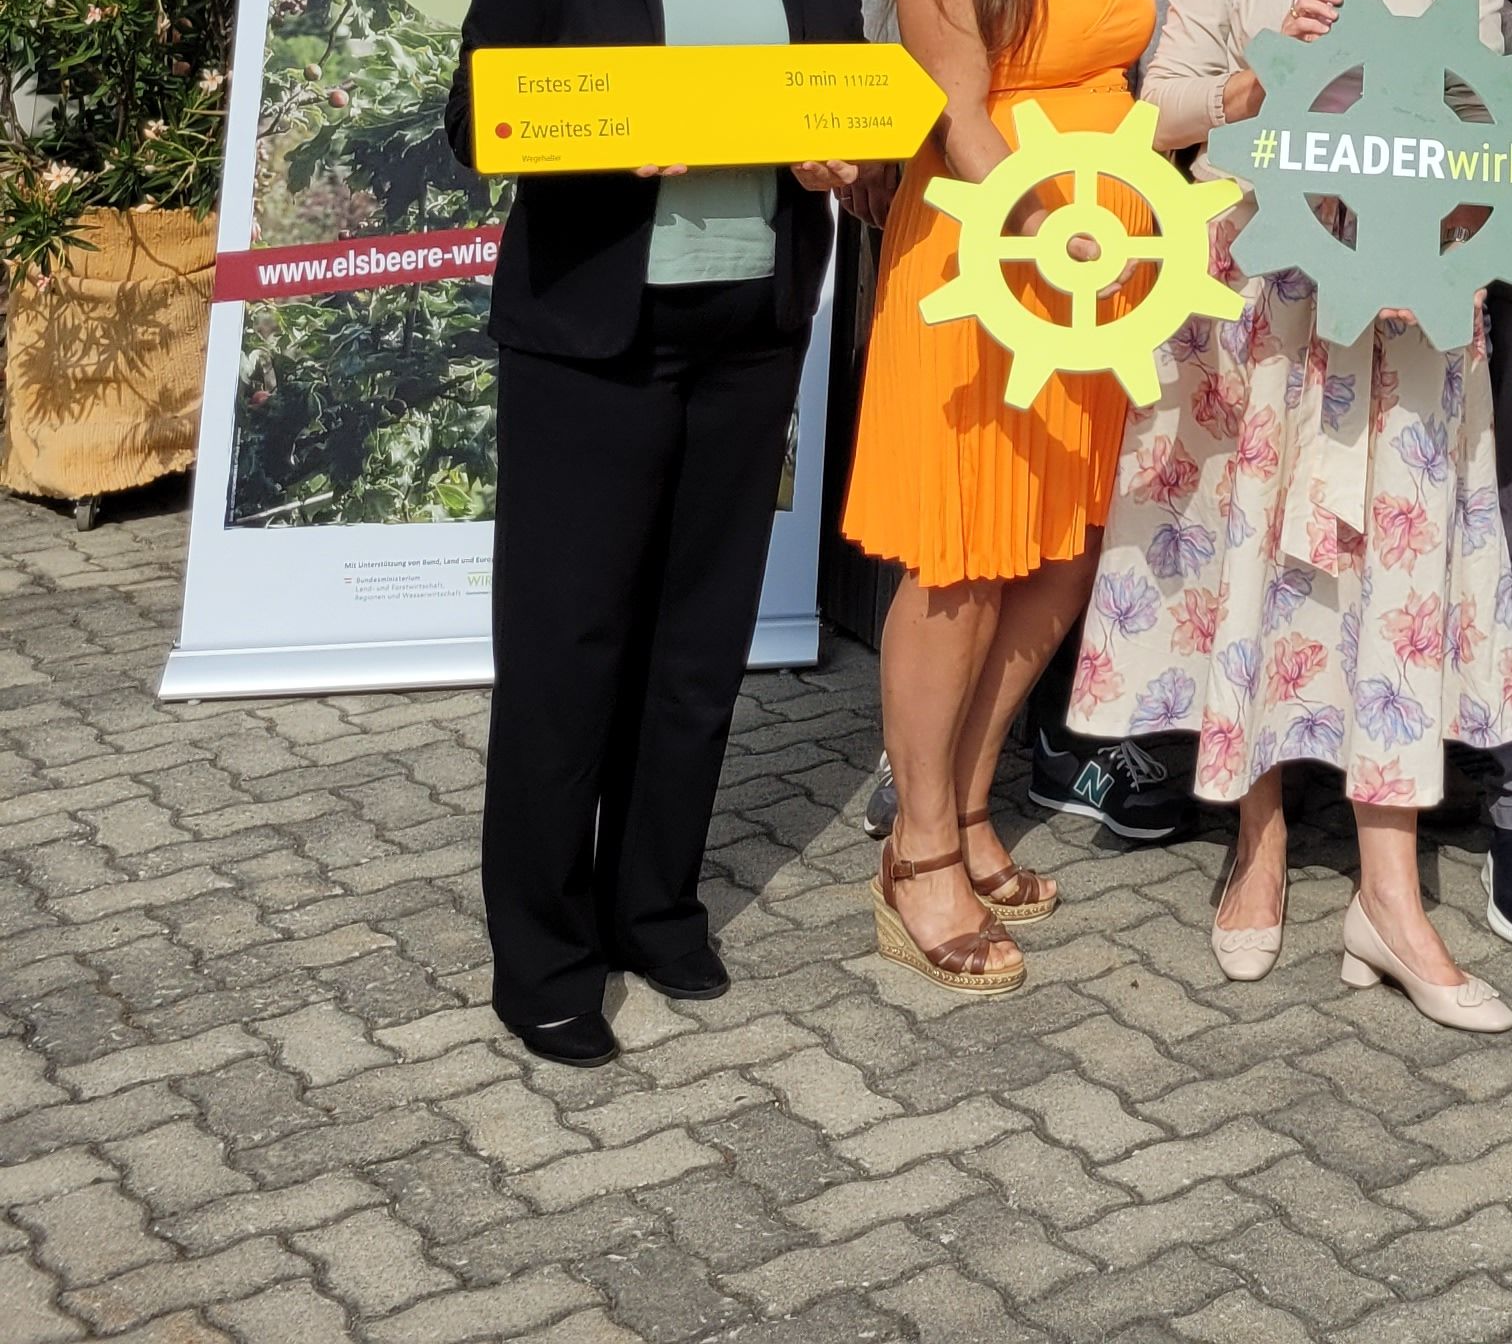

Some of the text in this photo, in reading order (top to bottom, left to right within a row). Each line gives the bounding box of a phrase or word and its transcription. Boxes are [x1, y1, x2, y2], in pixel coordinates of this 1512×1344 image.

[517, 73, 610, 95] Erstes Ziel
[784, 70, 889, 87] 30 min 111/222
[520, 118, 631, 139] Zweites Ziel
[847, 116, 893, 129] 333/444
[258, 236, 500, 286] www.elsbeere-wie
[1073, 760, 1115, 808] N
